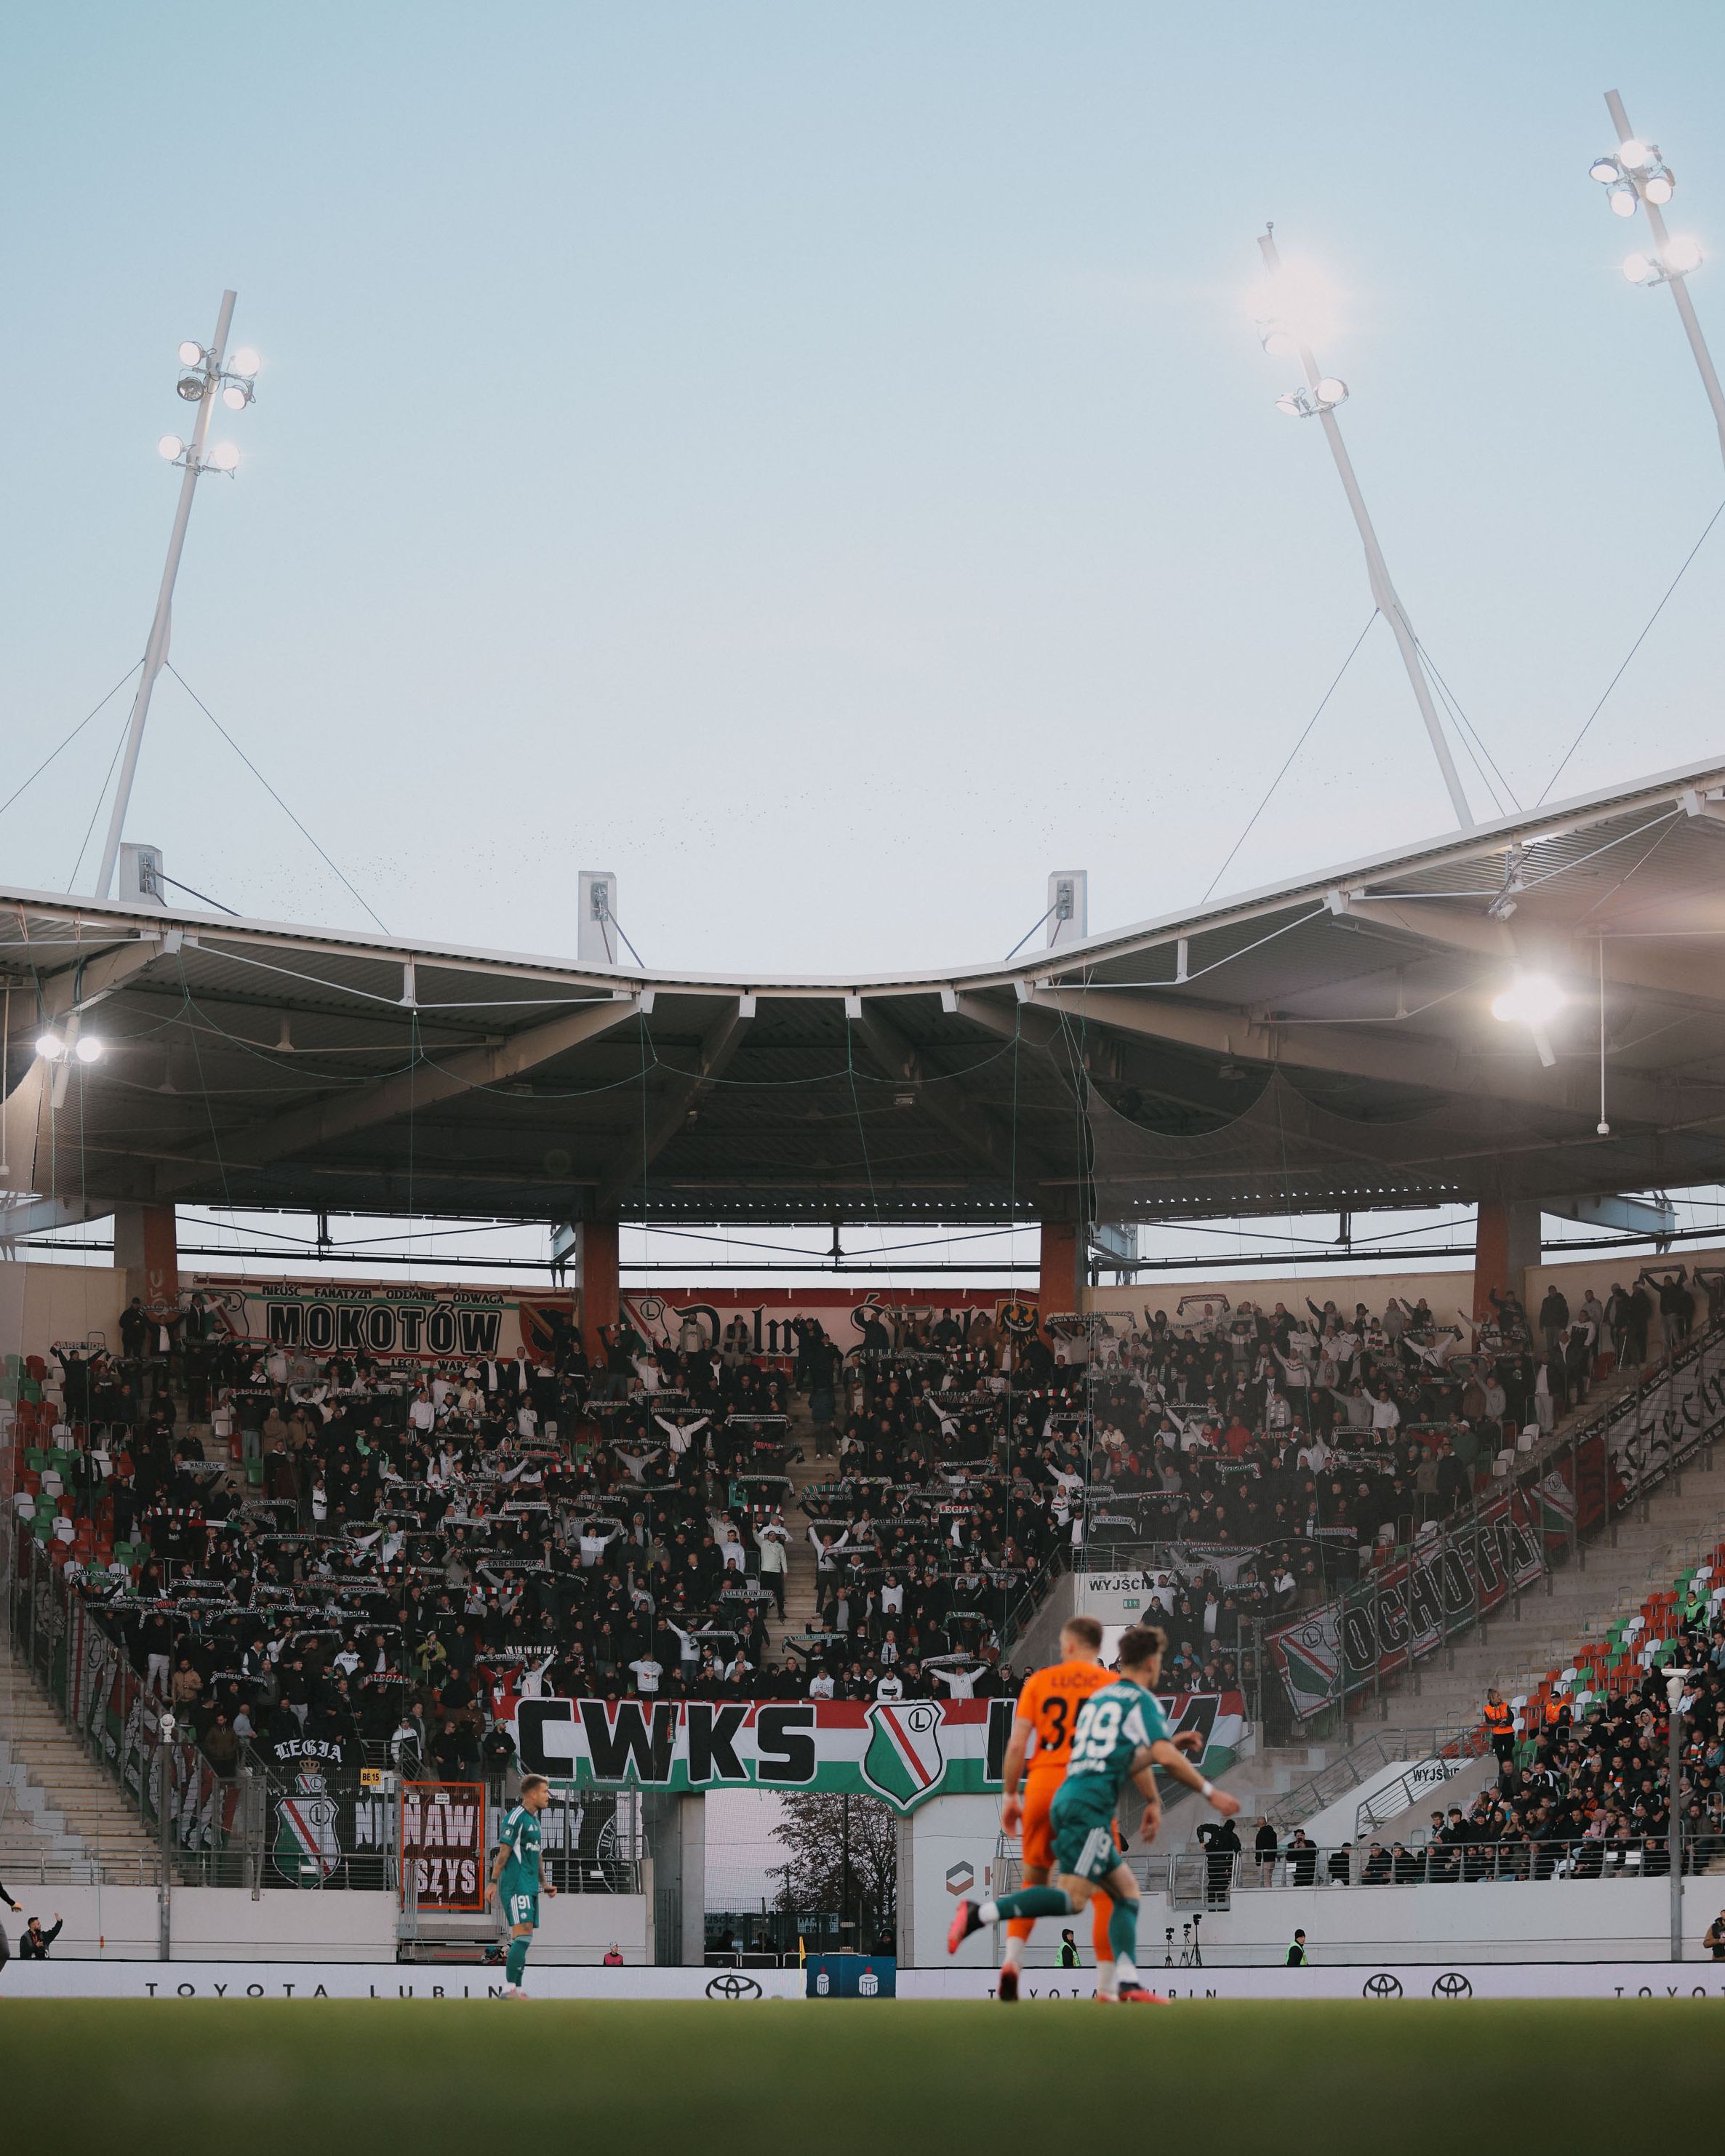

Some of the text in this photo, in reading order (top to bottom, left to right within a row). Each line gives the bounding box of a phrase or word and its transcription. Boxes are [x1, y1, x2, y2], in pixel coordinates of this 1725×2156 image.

[314, 1287, 372, 1300] FANATYZM
[386, 1290, 438, 1302] ODDANIE
[453, 1292, 505, 1305] ODWAGA
[266, 1301, 502, 1357] MOKOTÓW
[391, 1358, 422, 1368] LEGIA
[940, 1505, 969, 1514] LEGIA
[343, 1585, 379, 1594] GRÓJEC
[1333, 1512, 1535, 1671] OCHOTA
[374, 1674, 405, 1683] LEGIA
[515, 1696, 818, 1785] CWKS
[273, 1739, 343, 1763] LEGIA
[362, 1773, 380, 1782] BE 15
[1412, 1766, 1460, 1782] WYJŚIE
[517, 1895, 531, 1910] 91
[145, 1983, 328, 1998] TOYOTA
[988, 1988, 1099, 1999] TYOT
